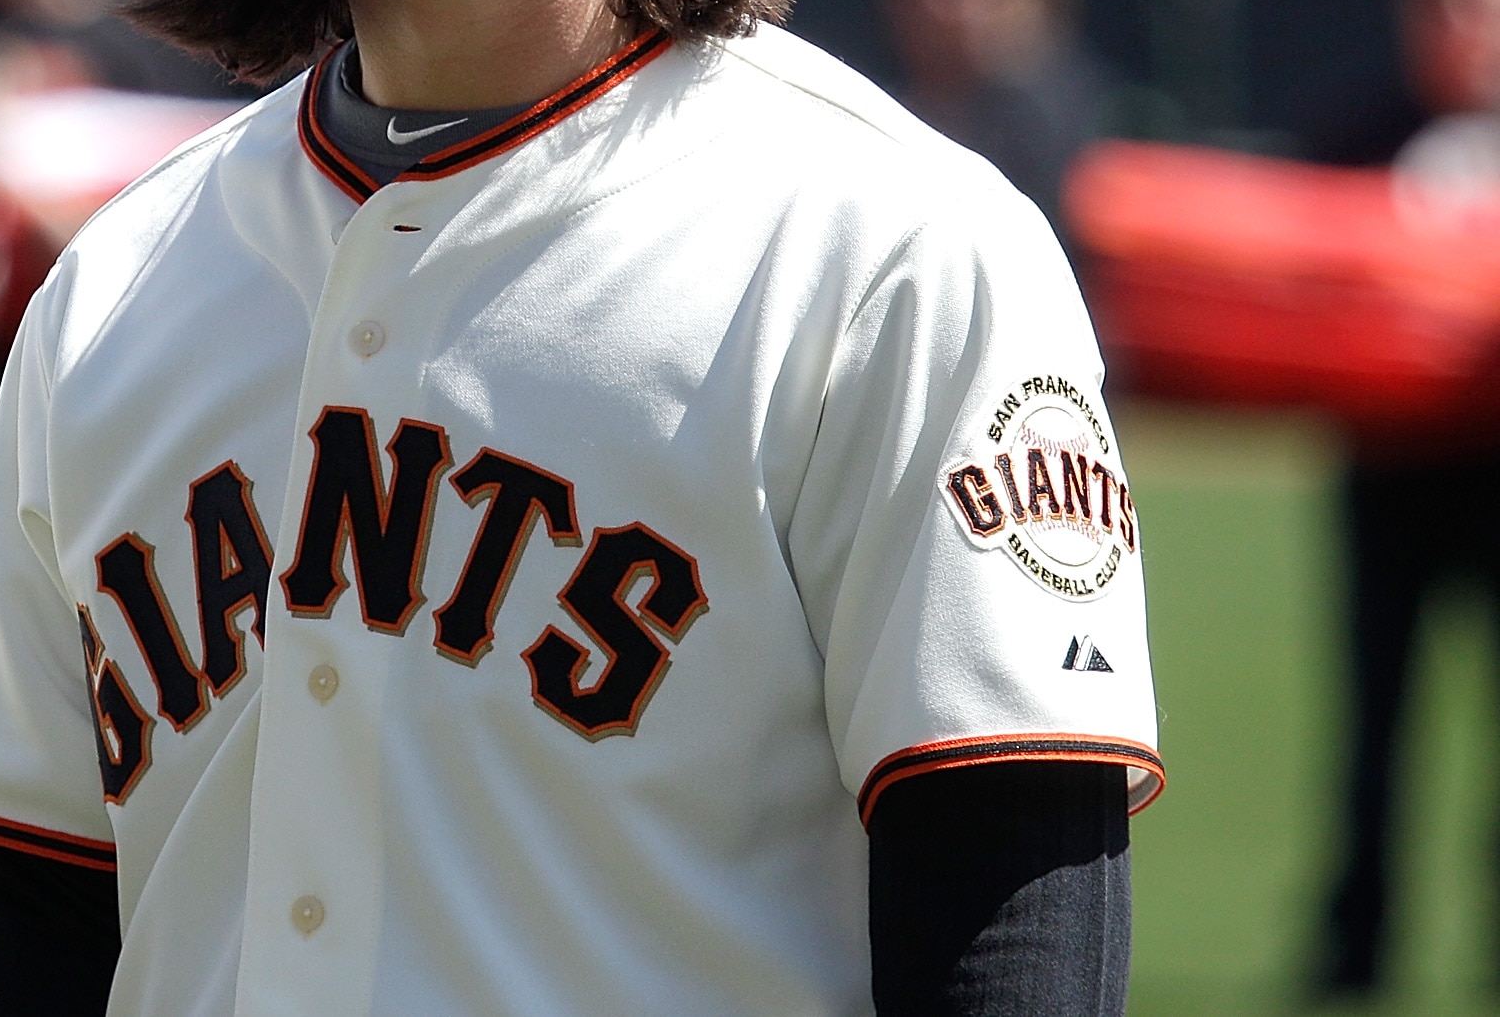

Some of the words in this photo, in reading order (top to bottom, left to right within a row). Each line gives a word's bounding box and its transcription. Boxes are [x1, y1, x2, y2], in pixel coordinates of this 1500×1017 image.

[986, 392, 1022, 445] SAN
[1021, 373, 1110, 455] FRANCISCO
[947, 447, 1137, 554] GIANTS
[1006, 532, 1095, 597] BASEBALL
[1094, 543, 1122, 589] CLUB
